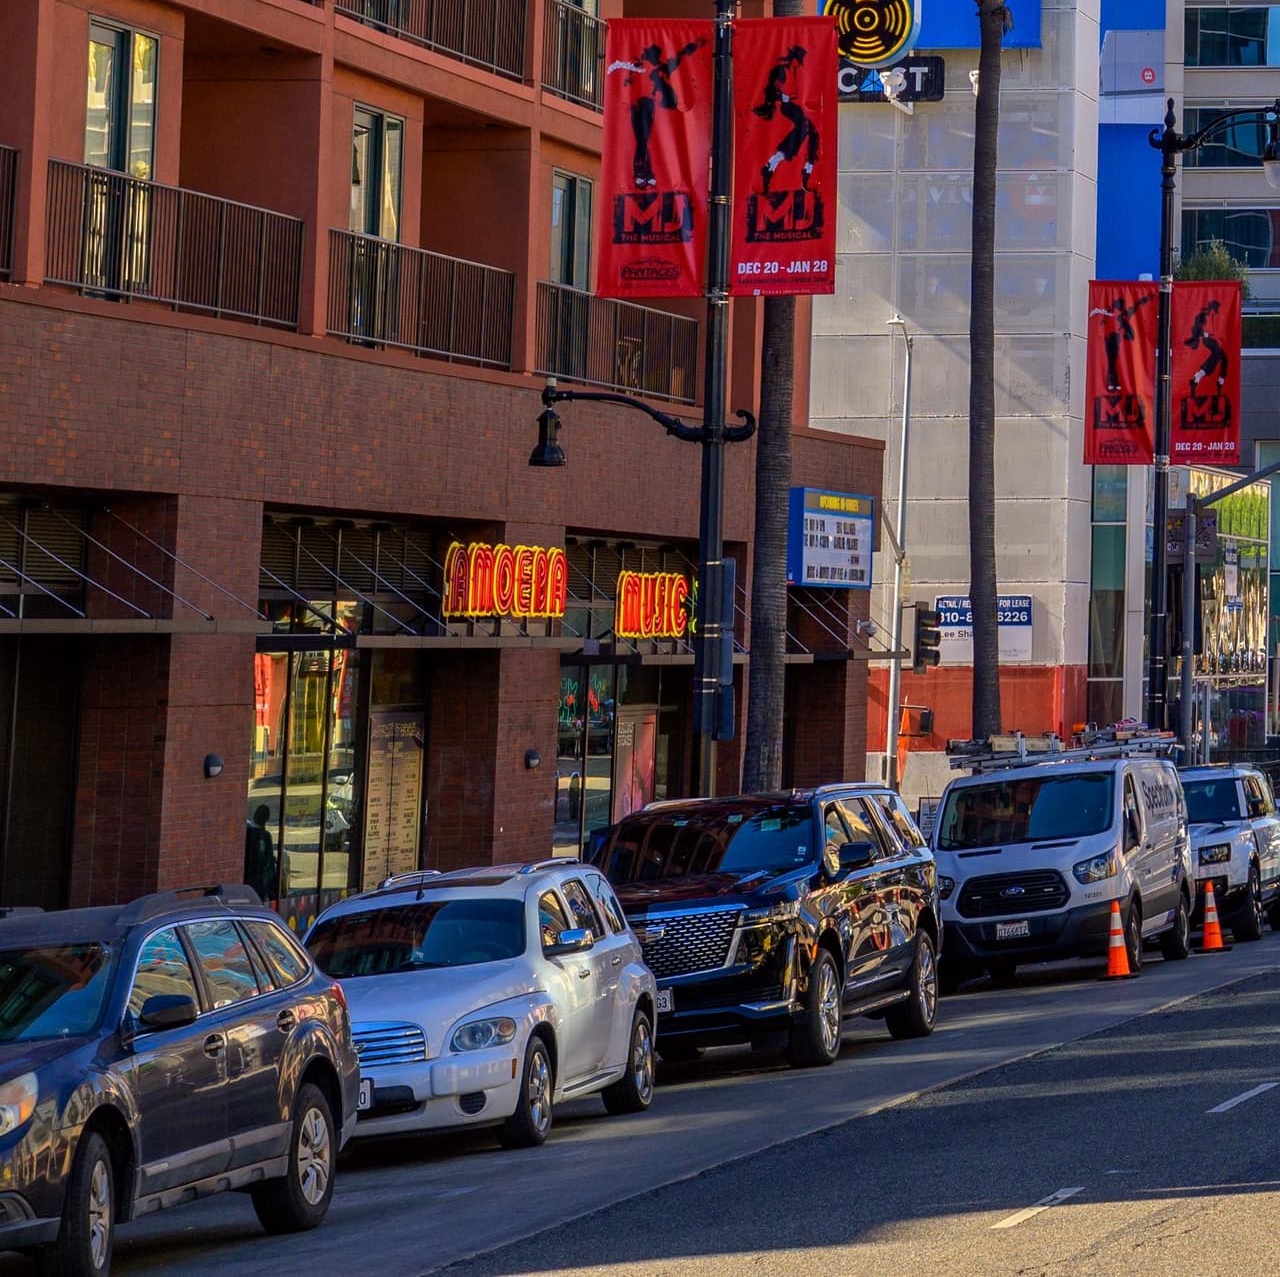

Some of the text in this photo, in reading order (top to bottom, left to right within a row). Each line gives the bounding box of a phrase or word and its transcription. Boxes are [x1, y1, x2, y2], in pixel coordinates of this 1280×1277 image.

[623, 192, 684, 233] MJ
[757, 192, 815, 232] MJ
[620, 234, 681, 242] THE MUSICAL
[774, 231, 812, 240] MUSICAL
[738, 262, 761, 274] DEC
[764, 261, 779, 274] 20
[787, 261, 811, 273] JAN
[813, 260, 828, 272] 28
[1100, 396, 1140, 423] MJ
[1187, 396, 1227, 423] MJ
[1176, 442, 1191, 450] DEC
[1193, 442, 1202, 450] 20
[1208, 442, 1223, 450] JAN
[442, 542, 568, 617] AMOEBA
[616, 570, 688, 638] MUSIC
[1012, 599, 1030, 608] LEASE
